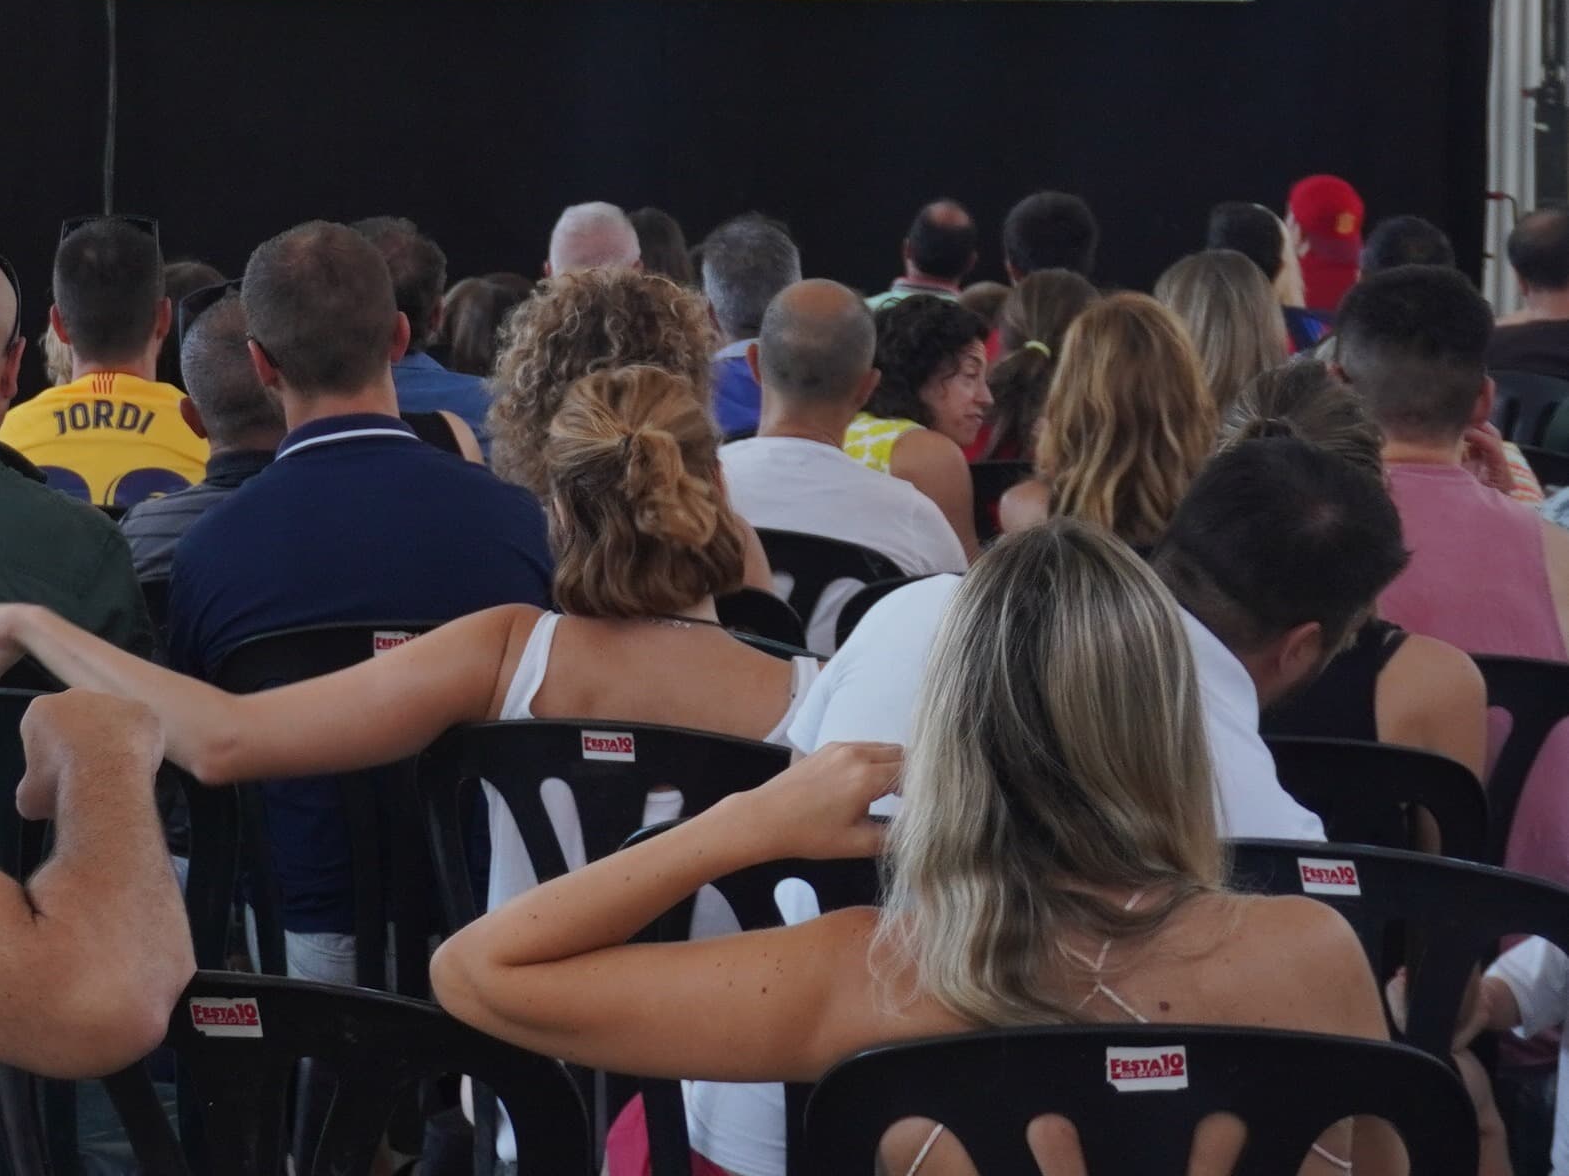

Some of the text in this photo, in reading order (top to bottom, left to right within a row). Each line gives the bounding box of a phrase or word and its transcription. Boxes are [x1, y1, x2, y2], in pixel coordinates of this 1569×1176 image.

[54, 399, 155, 436] JORDI
[376, 635, 415, 646] FESTA
[583, 736, 632, 749] FESTA10
[1301, 866, 1355, 880] FESTA10
[192, 1003, 257, 1019] FESTA10
[1110, 1053, 1184, 1073] FESTA10
